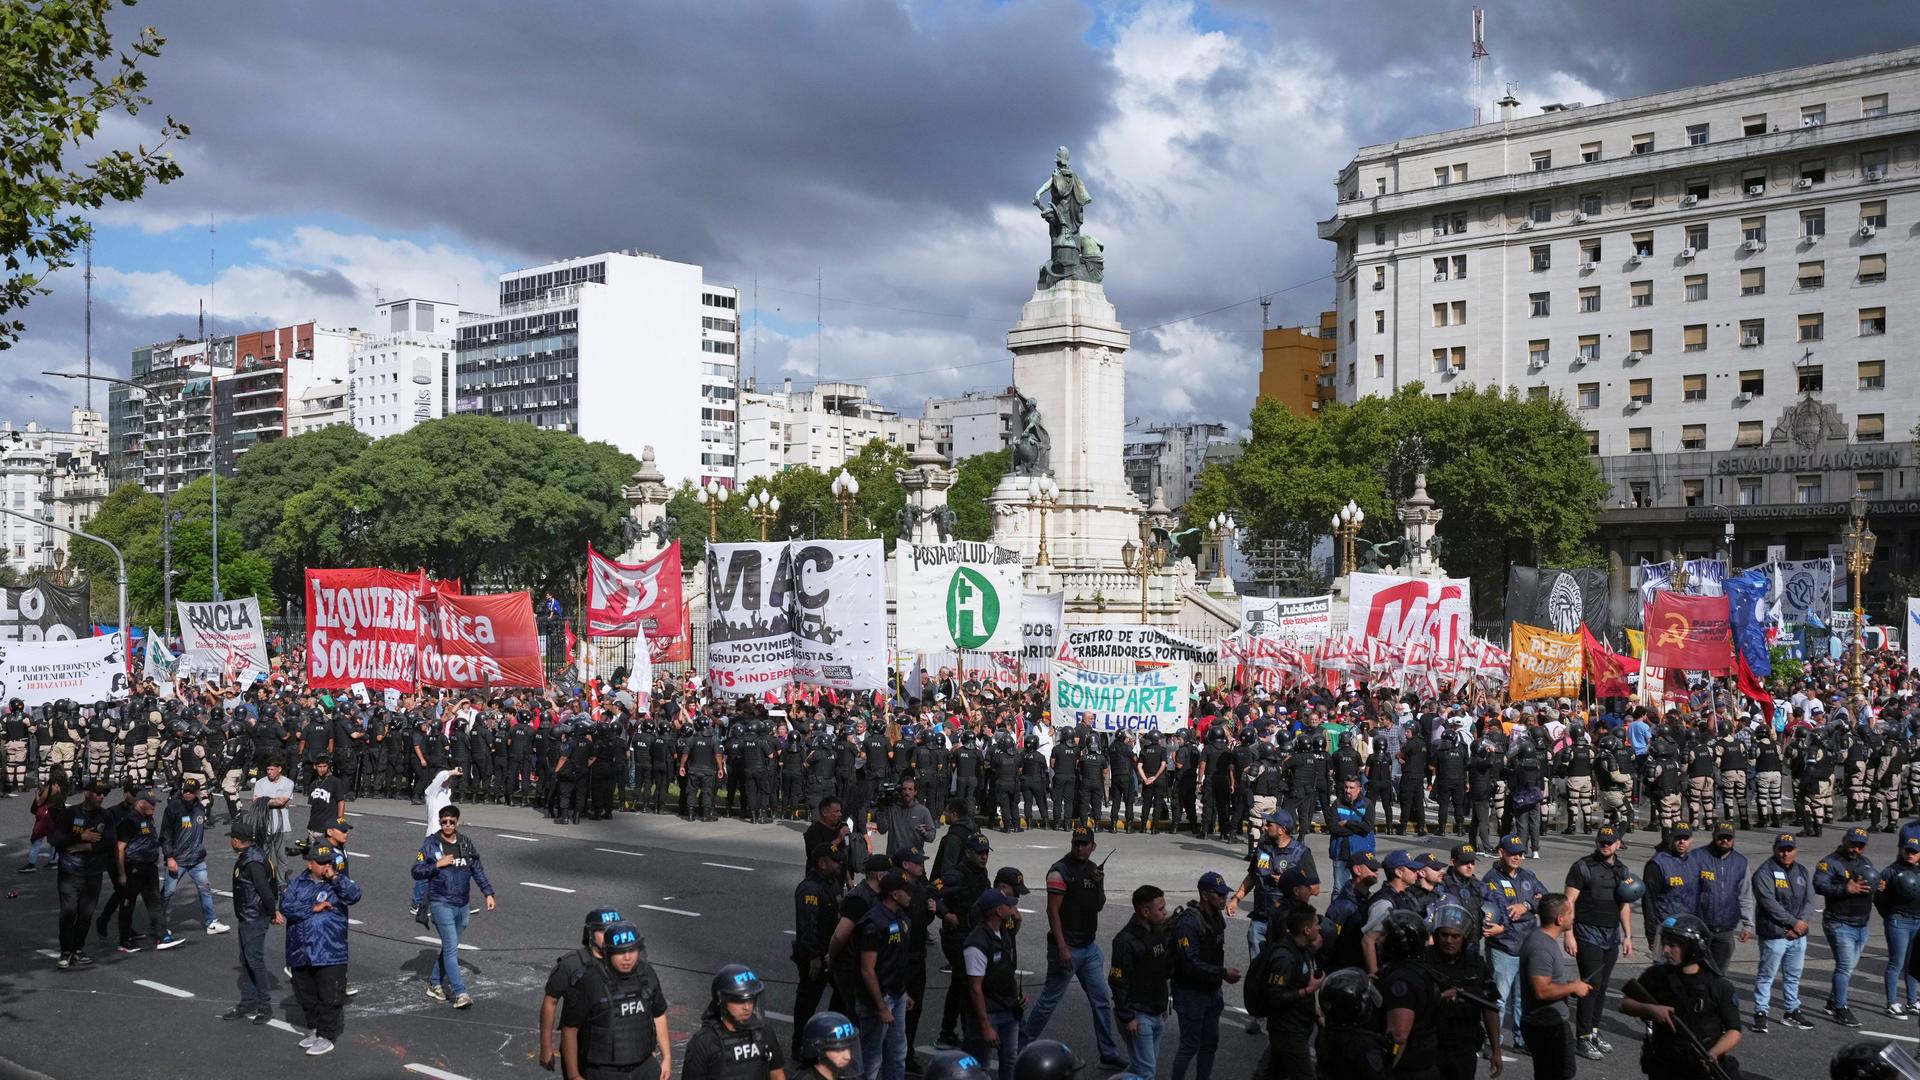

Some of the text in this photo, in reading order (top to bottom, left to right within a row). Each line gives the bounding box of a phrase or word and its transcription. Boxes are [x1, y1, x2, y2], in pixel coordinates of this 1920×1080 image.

[1718, 454, 1782, 474] SENADO
[1688, 508, 1729, 518] Edificio
[1733, 506, 1787, 518] SENADOR
[1791, 503, 1846, 516] ALFREDO
[708, 545, 834, 611] MAC
[1281, 602, 1328, 616] Jubiladxs
[188, 602, 253, 632] ANCLA
[1295, 615, 1328, 626] izquierda
[1069, 630, 1112, 645] CENTRO
[1118, 630, 1133, 643] DE
[52, 660, 101, 673] PERONISTAS
[22, 671, 89, 682] INDEPENDIENTES
[709, 668, 736, 688] PTS
[1075, 670, 1166, 687] HOSPITAL
[1057, 680, 1178, 714] BONAPARTE
[1104, 711, 1159, 731] LUCHA
[1677, 822, 1690, 830] PFA
[1855, 827, 1868, 837] PFA
[1256, 859, 1270, 870] PFA
[1669, 876, 1684, 887] PFA
[1700, 870, 1716, 881] PFA
[1774, 878, 1789, 889] PFA
[805, 895, 819, 907] PFA
[612, 932, 636, 946] PFA
[888, 932, 902, 945] PFA
[734, 970, 757, 984] PFA
[621, 999, 645, 1016] PFA
[733, 1042, 760, 1061] PFA
